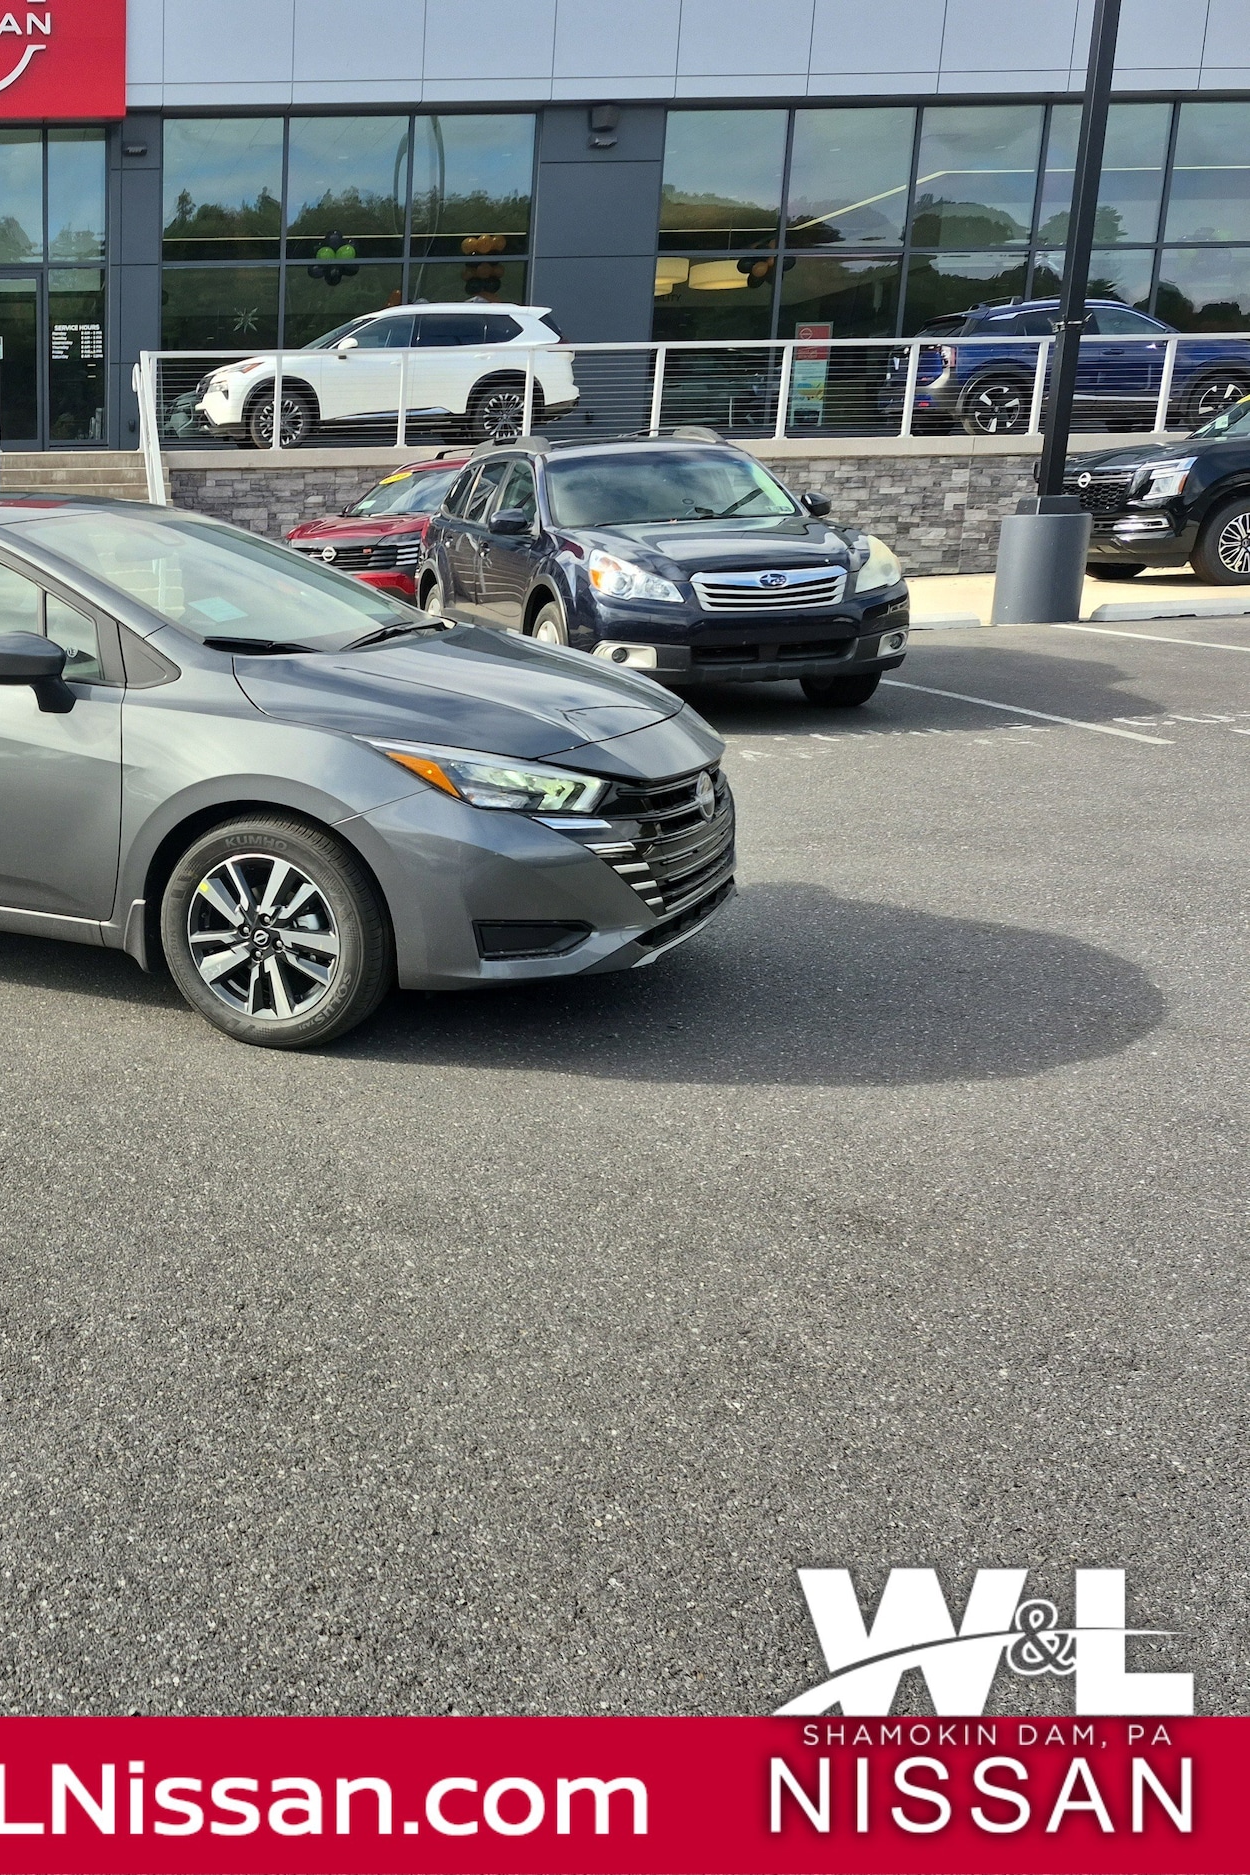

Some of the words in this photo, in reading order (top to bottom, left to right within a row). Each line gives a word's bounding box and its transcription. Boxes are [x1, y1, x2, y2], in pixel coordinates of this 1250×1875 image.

[79, 323, 100, 331] HOURS
[225, 835, 288, 852] KUMHO
[314, 972, 352, 1026] SOLUS
